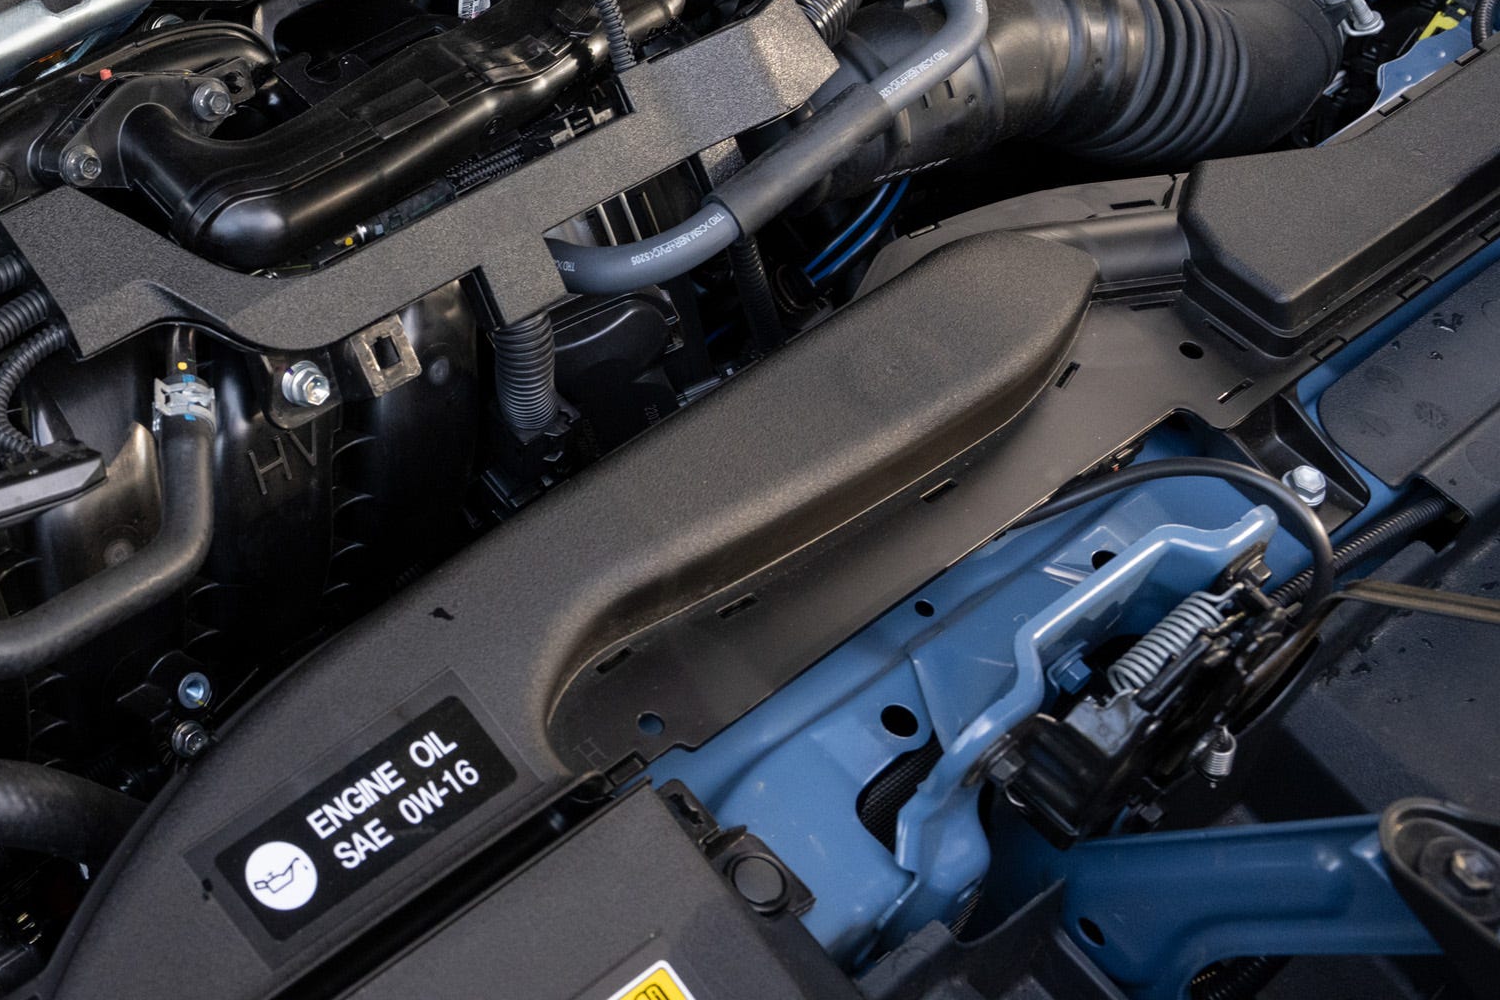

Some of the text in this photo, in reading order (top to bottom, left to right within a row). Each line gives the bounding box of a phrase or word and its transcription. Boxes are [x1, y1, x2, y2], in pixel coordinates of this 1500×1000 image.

[307, 732, 457, 838] ENGINE OIL
[334, 759, 479, 868] SAE 0W-16
